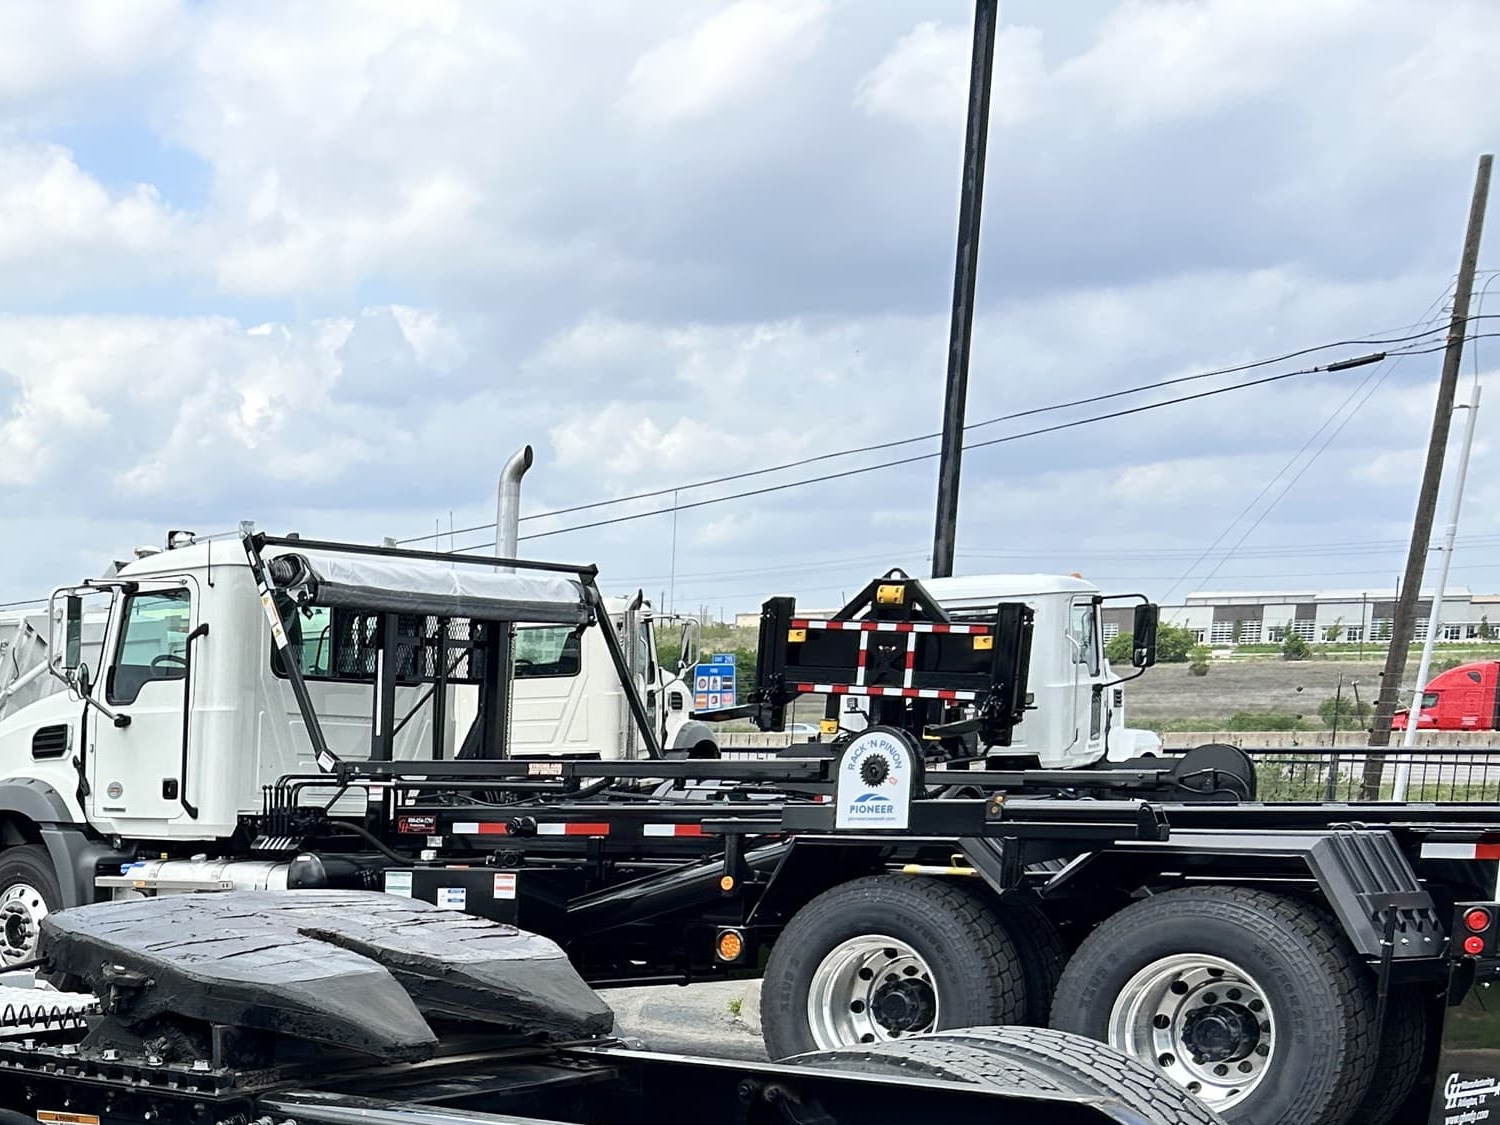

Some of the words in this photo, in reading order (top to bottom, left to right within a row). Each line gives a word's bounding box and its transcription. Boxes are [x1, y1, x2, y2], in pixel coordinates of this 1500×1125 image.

[847, 743, 868, 771] RACK
[879, 739, 903, 770] PINION
[849, 804, 894, 814] PIONEER
